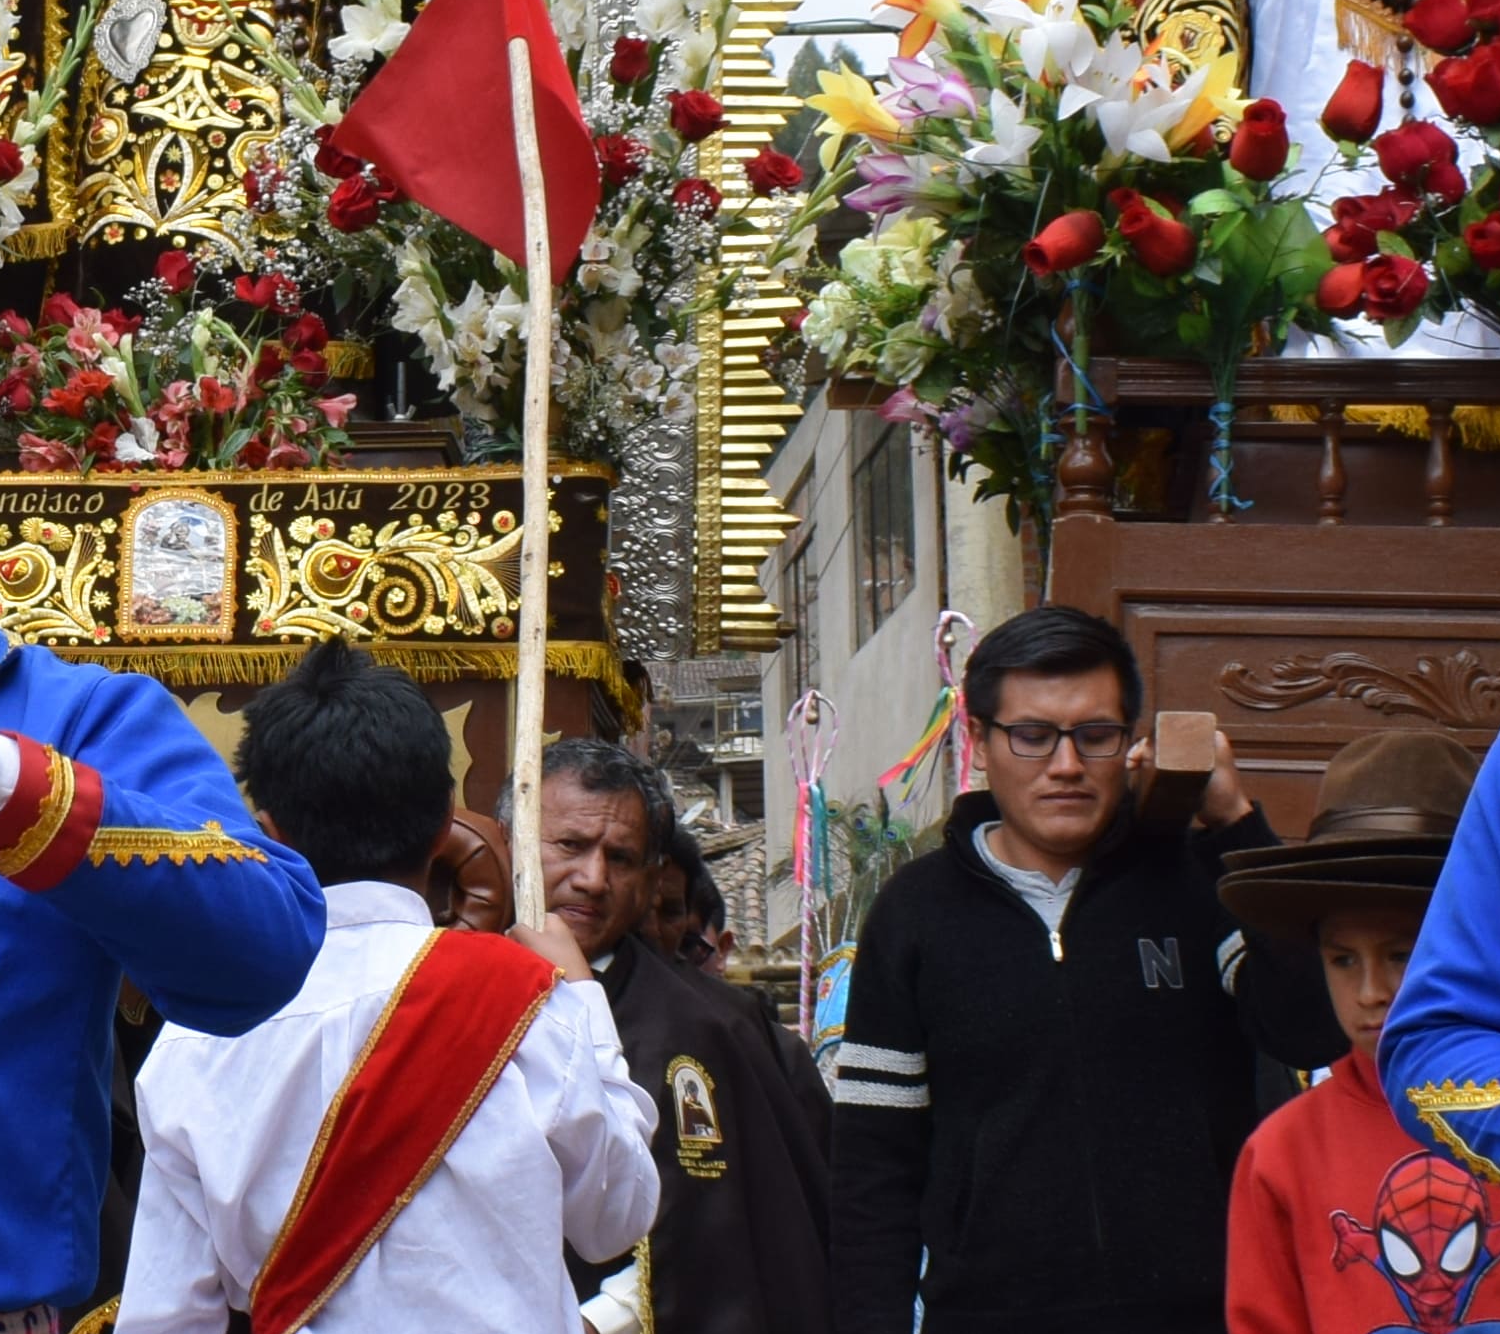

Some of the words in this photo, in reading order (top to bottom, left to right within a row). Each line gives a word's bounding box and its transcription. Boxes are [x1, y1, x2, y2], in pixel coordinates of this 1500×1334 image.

[249, 484, 284, 512] de
[388, 482, 491, 511] 2023
[1137, 936, 1185, 989] N
